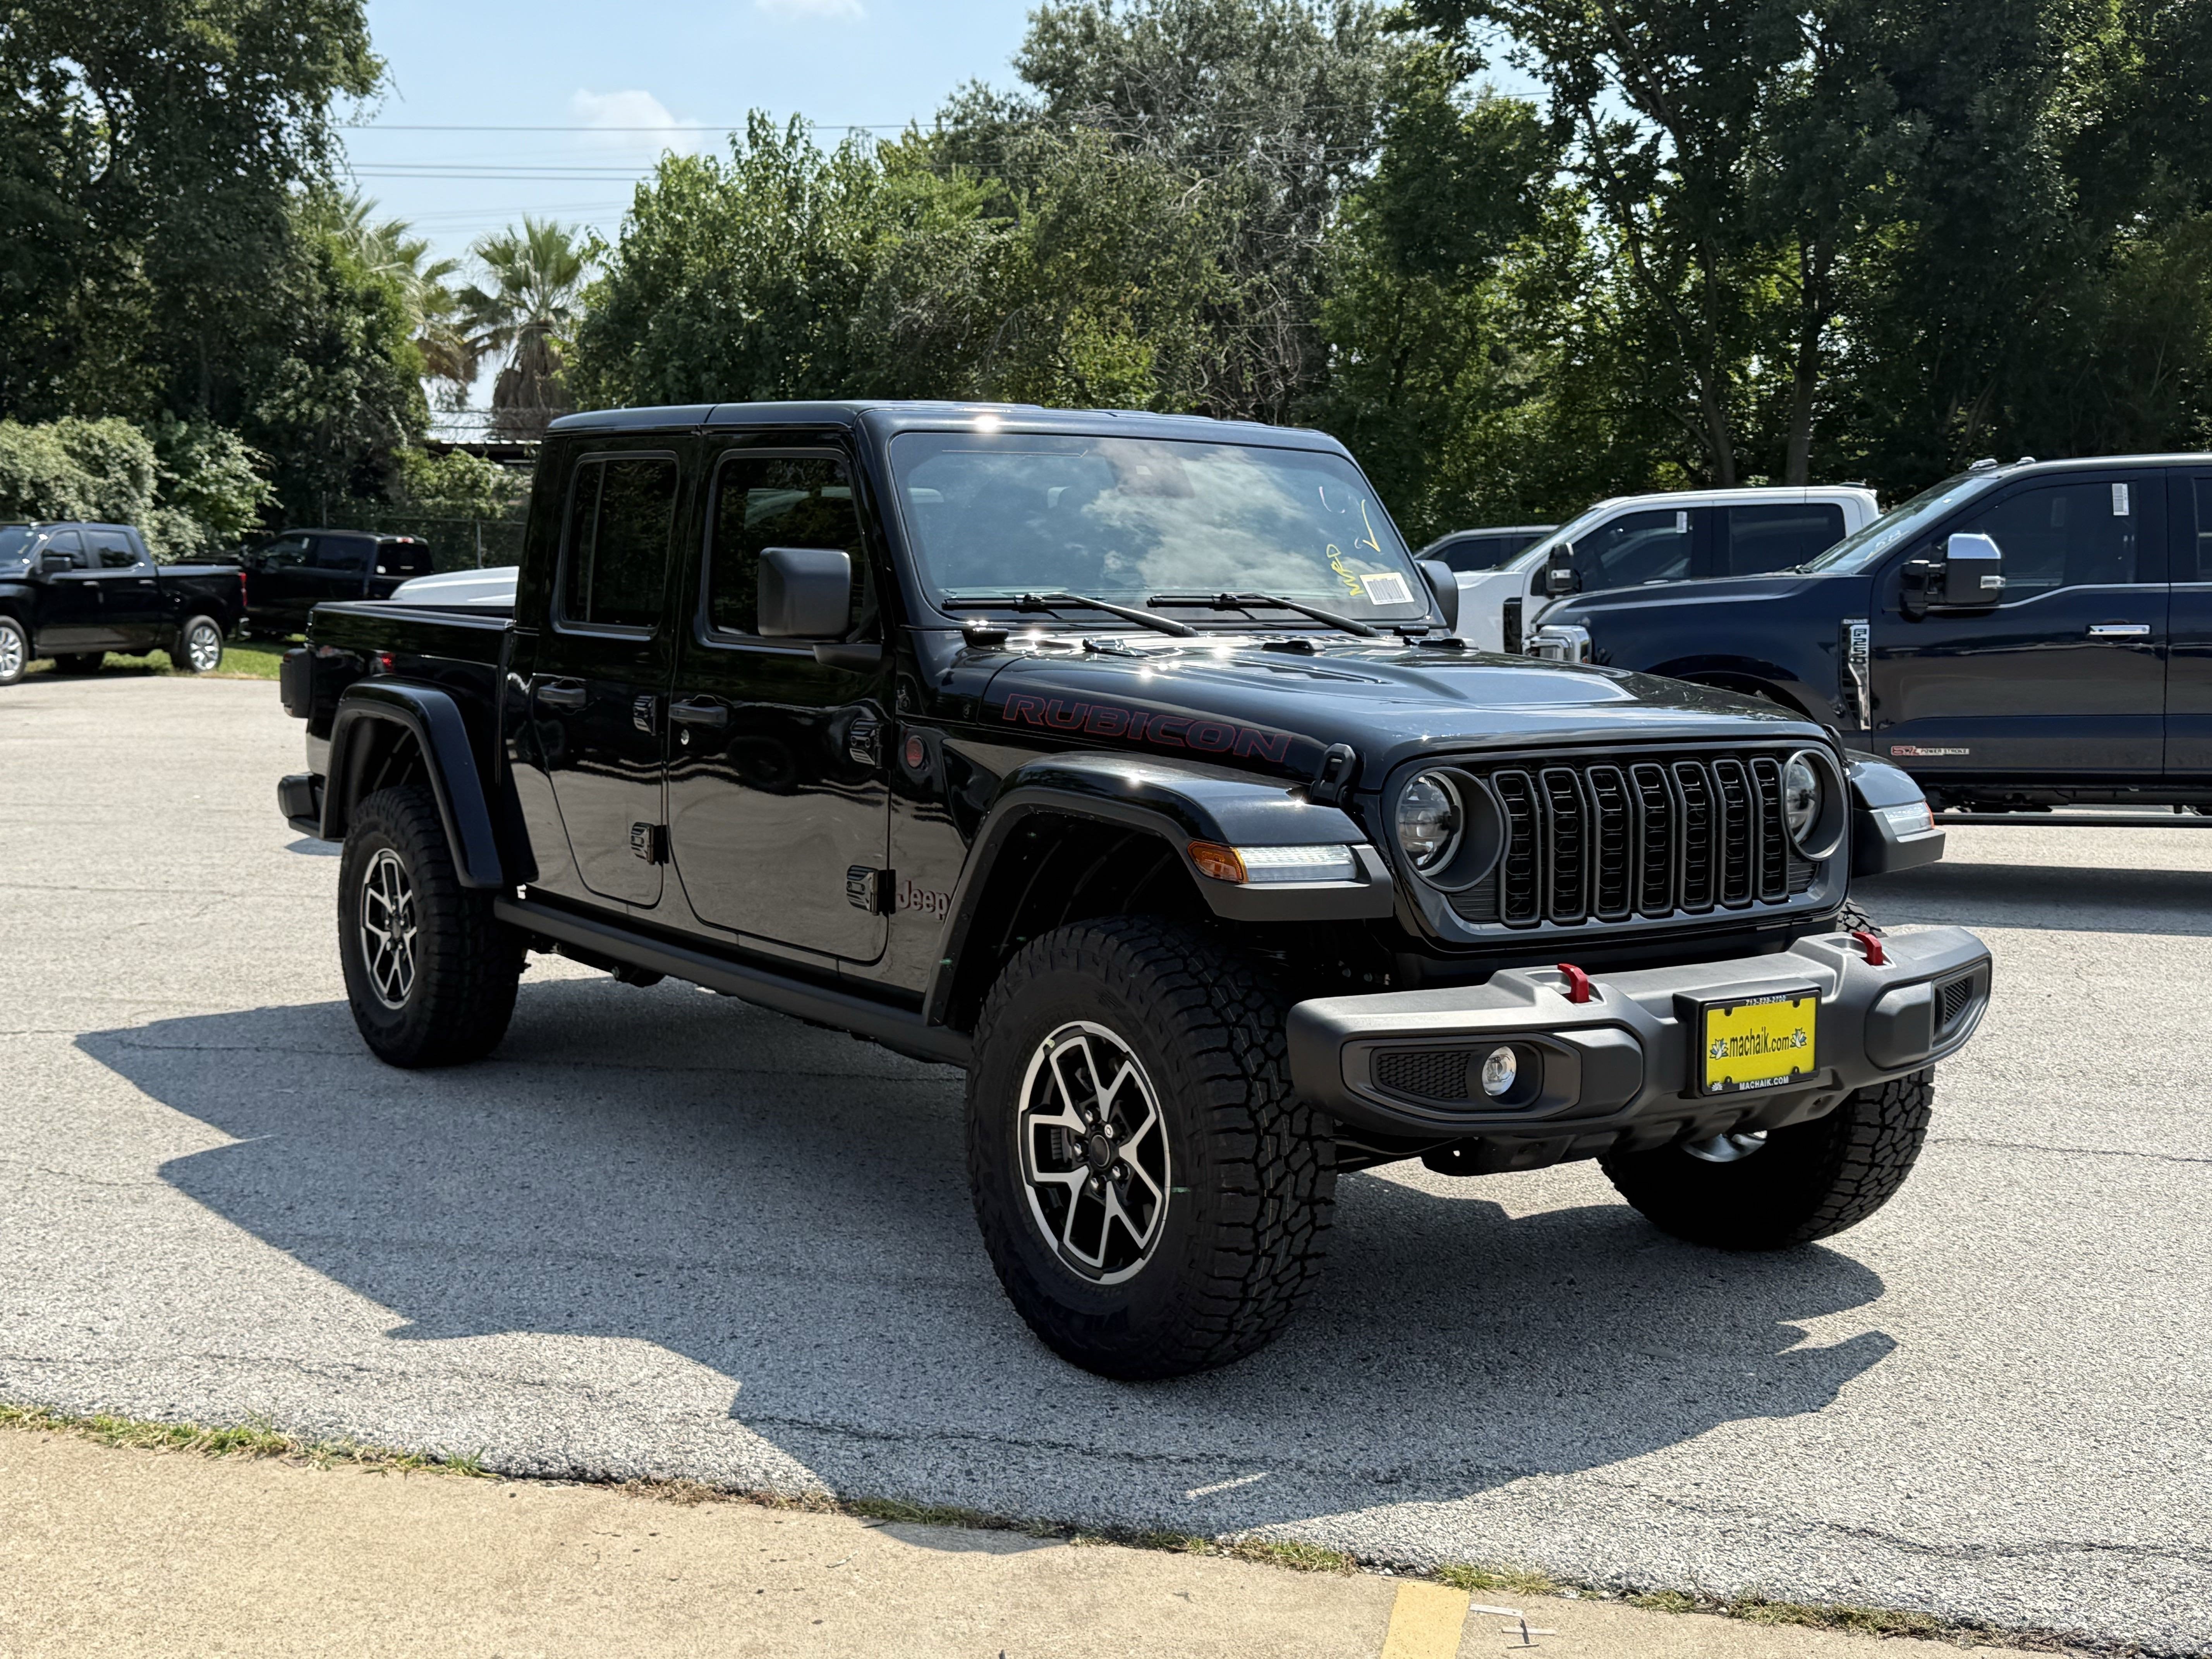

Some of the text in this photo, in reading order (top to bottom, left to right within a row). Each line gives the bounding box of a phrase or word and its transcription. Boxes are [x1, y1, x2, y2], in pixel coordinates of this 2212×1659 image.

[1002, 693, 1293, 763] RUBICON
[896, 880, 950, 921] Jeep
[1729, 1026, 1790, 1058] machaik.com
[1739, 1076, 1790, 1091] MACHAIK.COM
